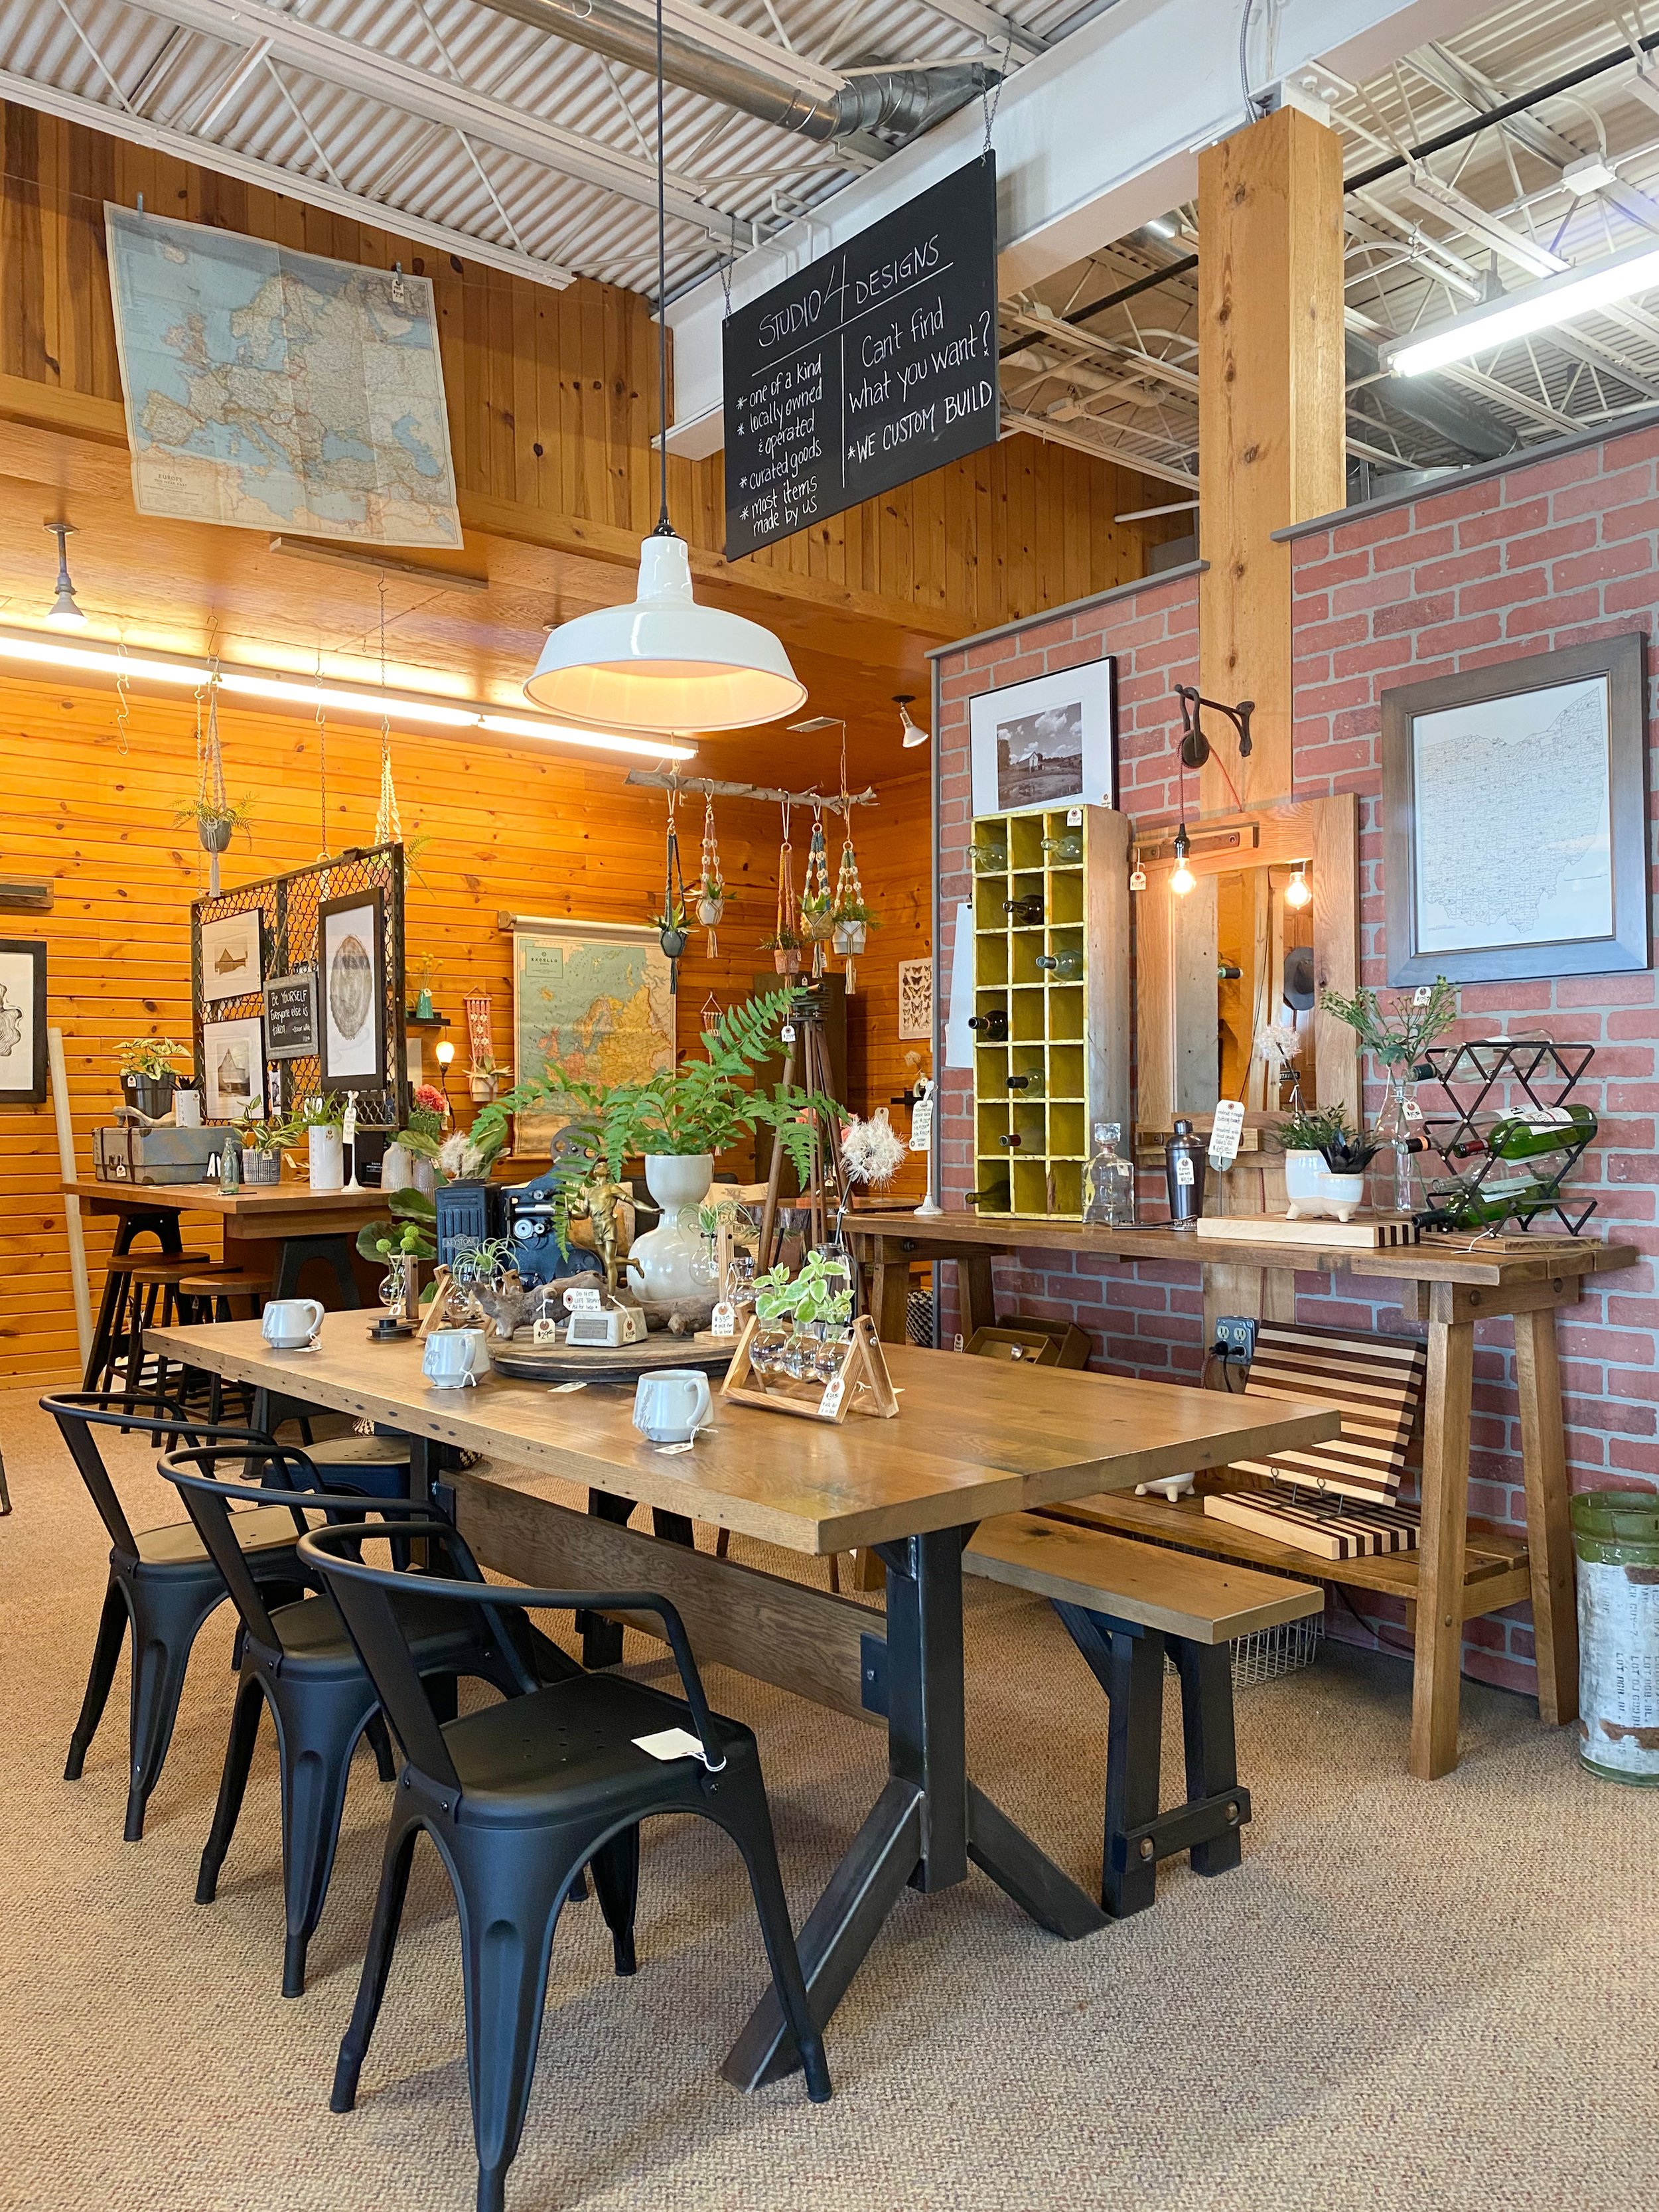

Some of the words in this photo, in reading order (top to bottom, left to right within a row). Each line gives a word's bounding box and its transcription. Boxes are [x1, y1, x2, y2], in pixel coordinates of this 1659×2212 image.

[759, 290, 821, 346] STUDIO
[824, 254, 849, 323] 4
[856, 234, 939, 304] DESIGNS
[863, 323, 903, 367] Can't
[911, 296, 944, 342] find
[750, 385, 767, 407] one
[771, 372, 783, 395] of
[785, 372, 792, 389] a
[797, 353, 822, 384] kind
[751, 401, 782, 433] locally
[786, 377, 822, 415] owned
[849, 370, 891, 413] what
[897, 359, 928, 402] you
[883, 404, 935, 450] CUSTOM
[944, 381, 992, 423] BUILD
[158, 474, 182, 482] EUROPE
[750, 451, 788, 489] curated
[790, 436, 822, 478] goods
[752, 488, 778, 519] most
[783, 476, 817, 504] items
[753, 509, 779, 536] made
[785, 506, 798, 526] by
[270, 1009, 290, 1023] Everyone
[291, 1005, 301, 1017] else
[303, 1004, 308, 1017] is
[281, 990, 308, 1003] YOURSELF
